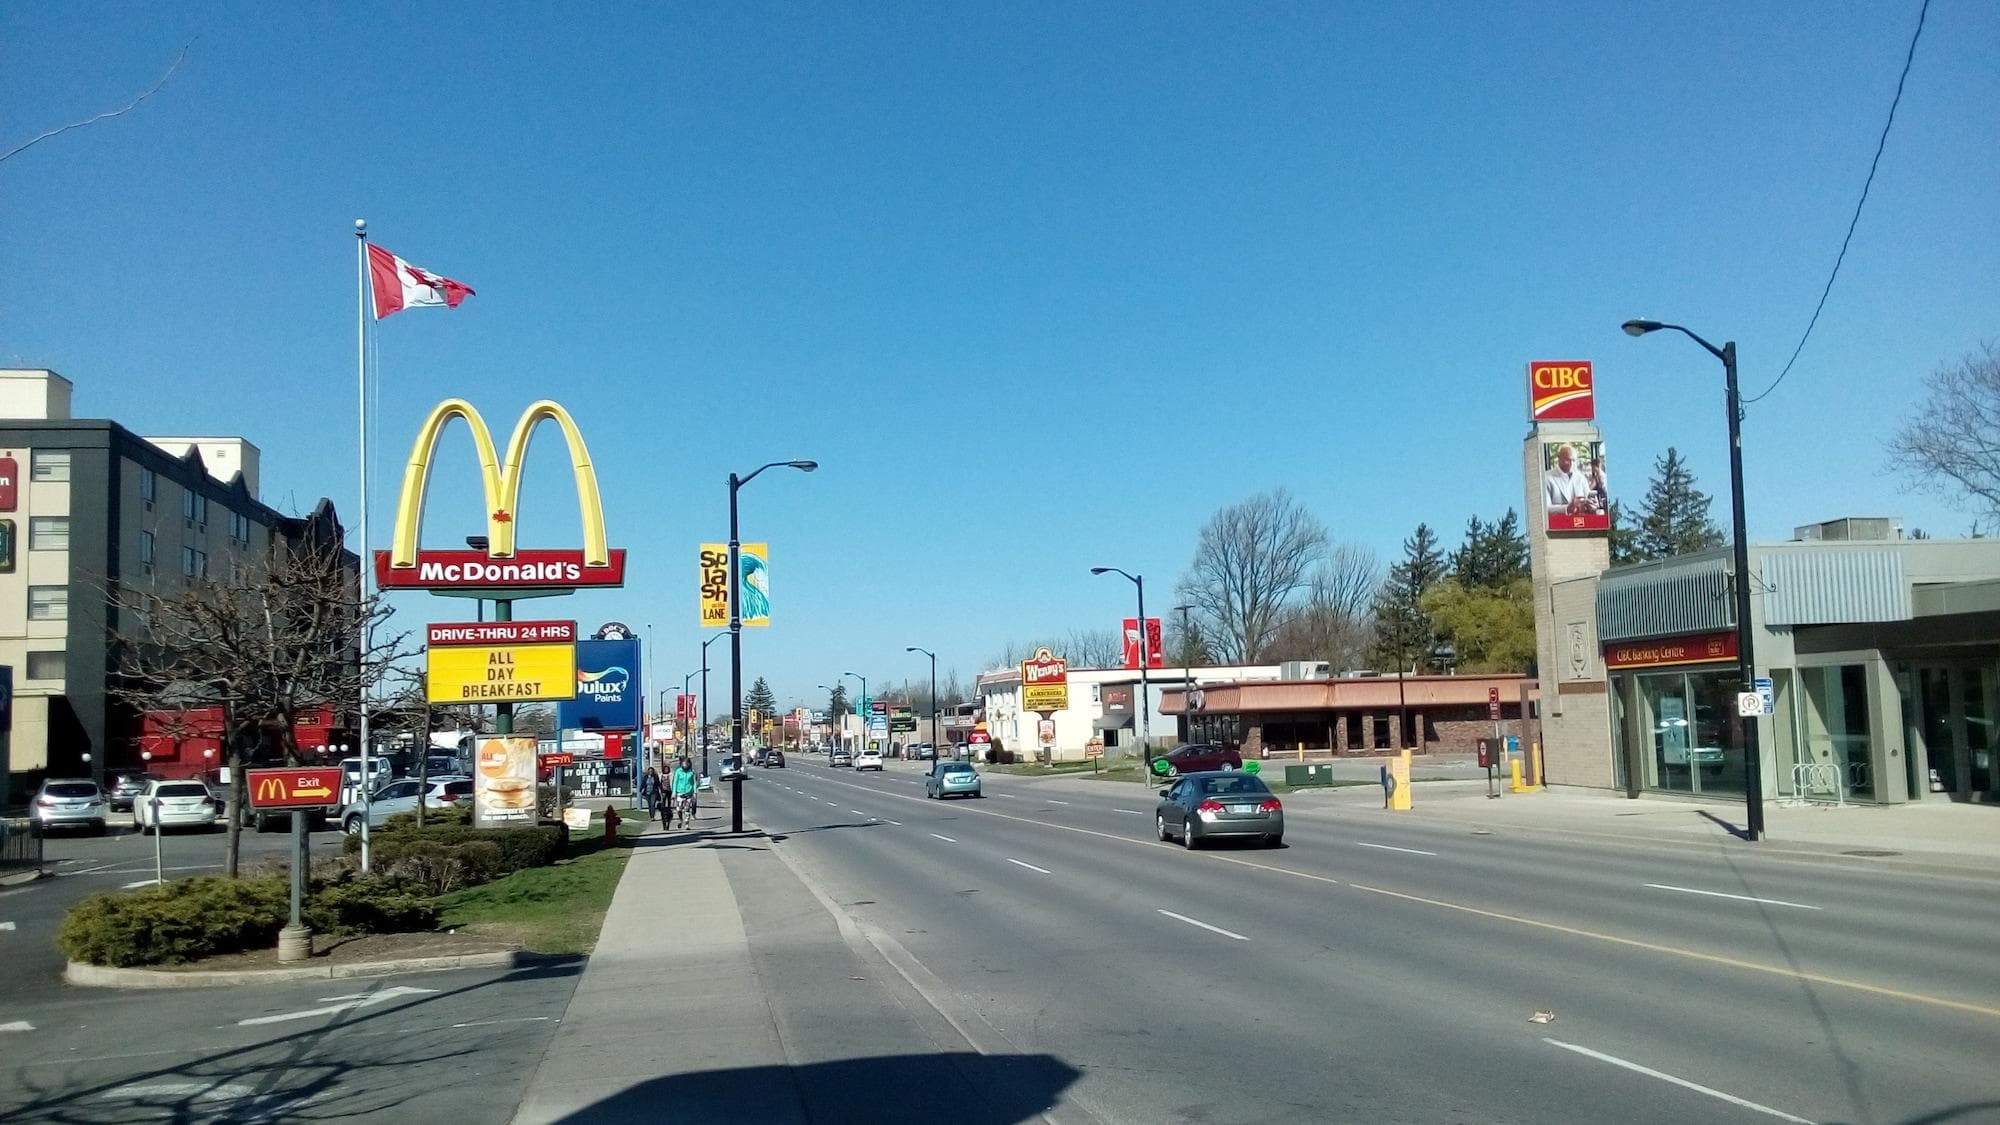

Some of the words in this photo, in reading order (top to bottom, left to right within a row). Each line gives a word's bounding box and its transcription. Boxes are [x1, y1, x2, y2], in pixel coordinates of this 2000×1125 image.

[1535, 366, 1589, 389] CIBC
[419, 562, 581, 581] McDonald's
[703, 608, 726, 620] LANE
[431, 627, 517, 641] DRIVE-THRU
[521, 627, 538, 639] 24
[540, 625, 571, 638] HRS
[488, 652, 514, 664] ALL
[1632, 649, 1659, 662] Banking
[1660, 646, 1685, 658] Centre
[487, 668, 514, 681] DAY
[462, 682, 542, 698] BREAKFAST
[594, 694, 622, 703] Paints
[297, 777, 321, 788] Exit
[581, 775, 600, 783] FREE
